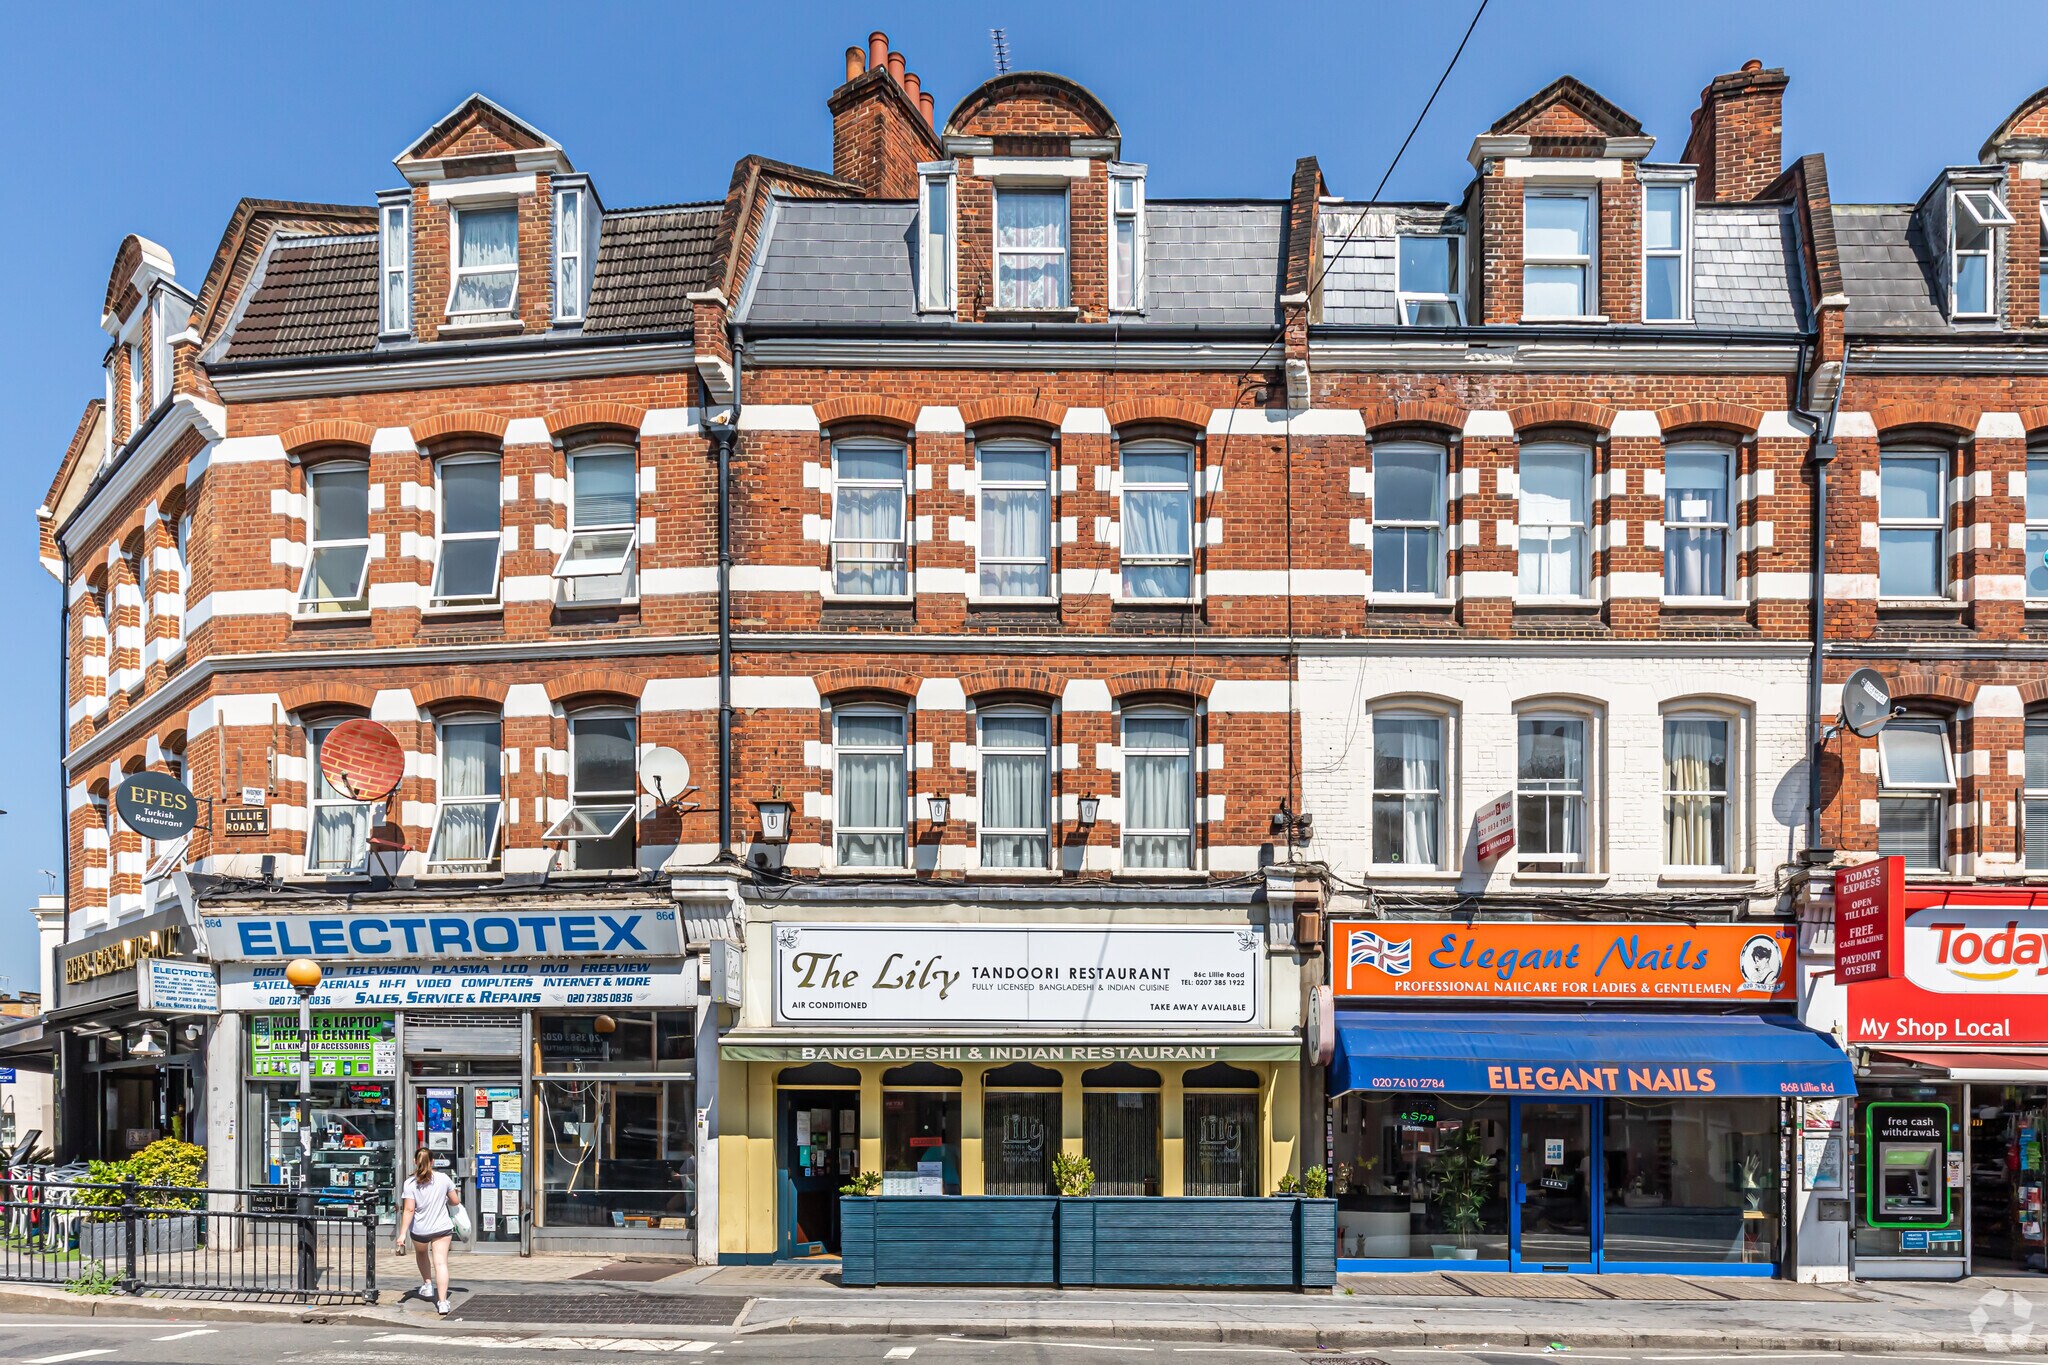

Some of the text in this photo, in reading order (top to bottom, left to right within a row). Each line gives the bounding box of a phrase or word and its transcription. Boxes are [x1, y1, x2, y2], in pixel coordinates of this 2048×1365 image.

[130, 786, 188, 810] EFES
[144, 808, 174, 819] Turkish
[230, 812, 262, 820] LILLIE
[135, 814, 183, 827] Restaurant
[1489, 835, 1510, 849] MANAGED
[1845, 866, 1880, 883] TODAY'S
[1843, 877, 1881, 894] EXPRESS
[1851, 897, 1872, 909] OPEN
[656, 911, 675, 921] 86d
[1845, 906, 1879, 920] TILL LATE
[204, 918, 222, 929] 86d
[237, 915, 647, 956] ELECTROTEX
[1849, 924, 1874, 938] FREE
[1840, 934, 1884, 948] CASH MACHINE
[1429, 933, 1708, 980] Elegant Nails
[1841, 950, 1881, 965] PAYPOINT
[153, 967, 215, 978] ELECTROTEX
[253, 963, 650, 977] DIGIT TELEVISION PLASMA LCD DVD FREEVIEW
[792, 952, 960, 1000] The Lily
[971, 966, 1170, 980] TANDOORI RESTAURANT
[1845, 963, 1876, 976] OYSTER
[253, 977, 651, 990] SATELL AERIALS HI-FI VIDEO COMPUTERS INTERNET & MORE
[972, 983, 993, 991] FULLY
[997, 983, 1035, 991] LICENSED
[1394, 981, 1731, 994] PROFESSIONAL NAILCARE FOR LADIES & GENTLEMEN
[269, 996, 331, 1005] 020 738 0836
[406, 991, 464, 1004] SERVICE
[466, 993, 475, 1003] &
[479, 990, 541, 1003] REPAIRS
[567, 993, 633, 1003] 020 7385 0836
[792, 1001, 868, 1009] AIR CONDITIONED
[272, 1016, 381, 1028] MOBE & LAPTOP
[1860, 1018, 2010, 1039] My Shop Local
[321, 1030, 370, 1041] CENTRE
[801, 1046, 1219, 1060] BANGLADESHI & INDIAN RESTAURANT
[1372, 1078, 1445, 1088] 020 7610 2784
[1487, 1066, 1716, 1091] ELEGANT NAILS
[1781, 1082, 1834, 1092] 86B Lillie Rd
[1410, 1112, 1434, 1121] Spa
[1888, 1117, 1934, 1126] free cash
[1882, 1128, 1940, 1137] withdrawals
